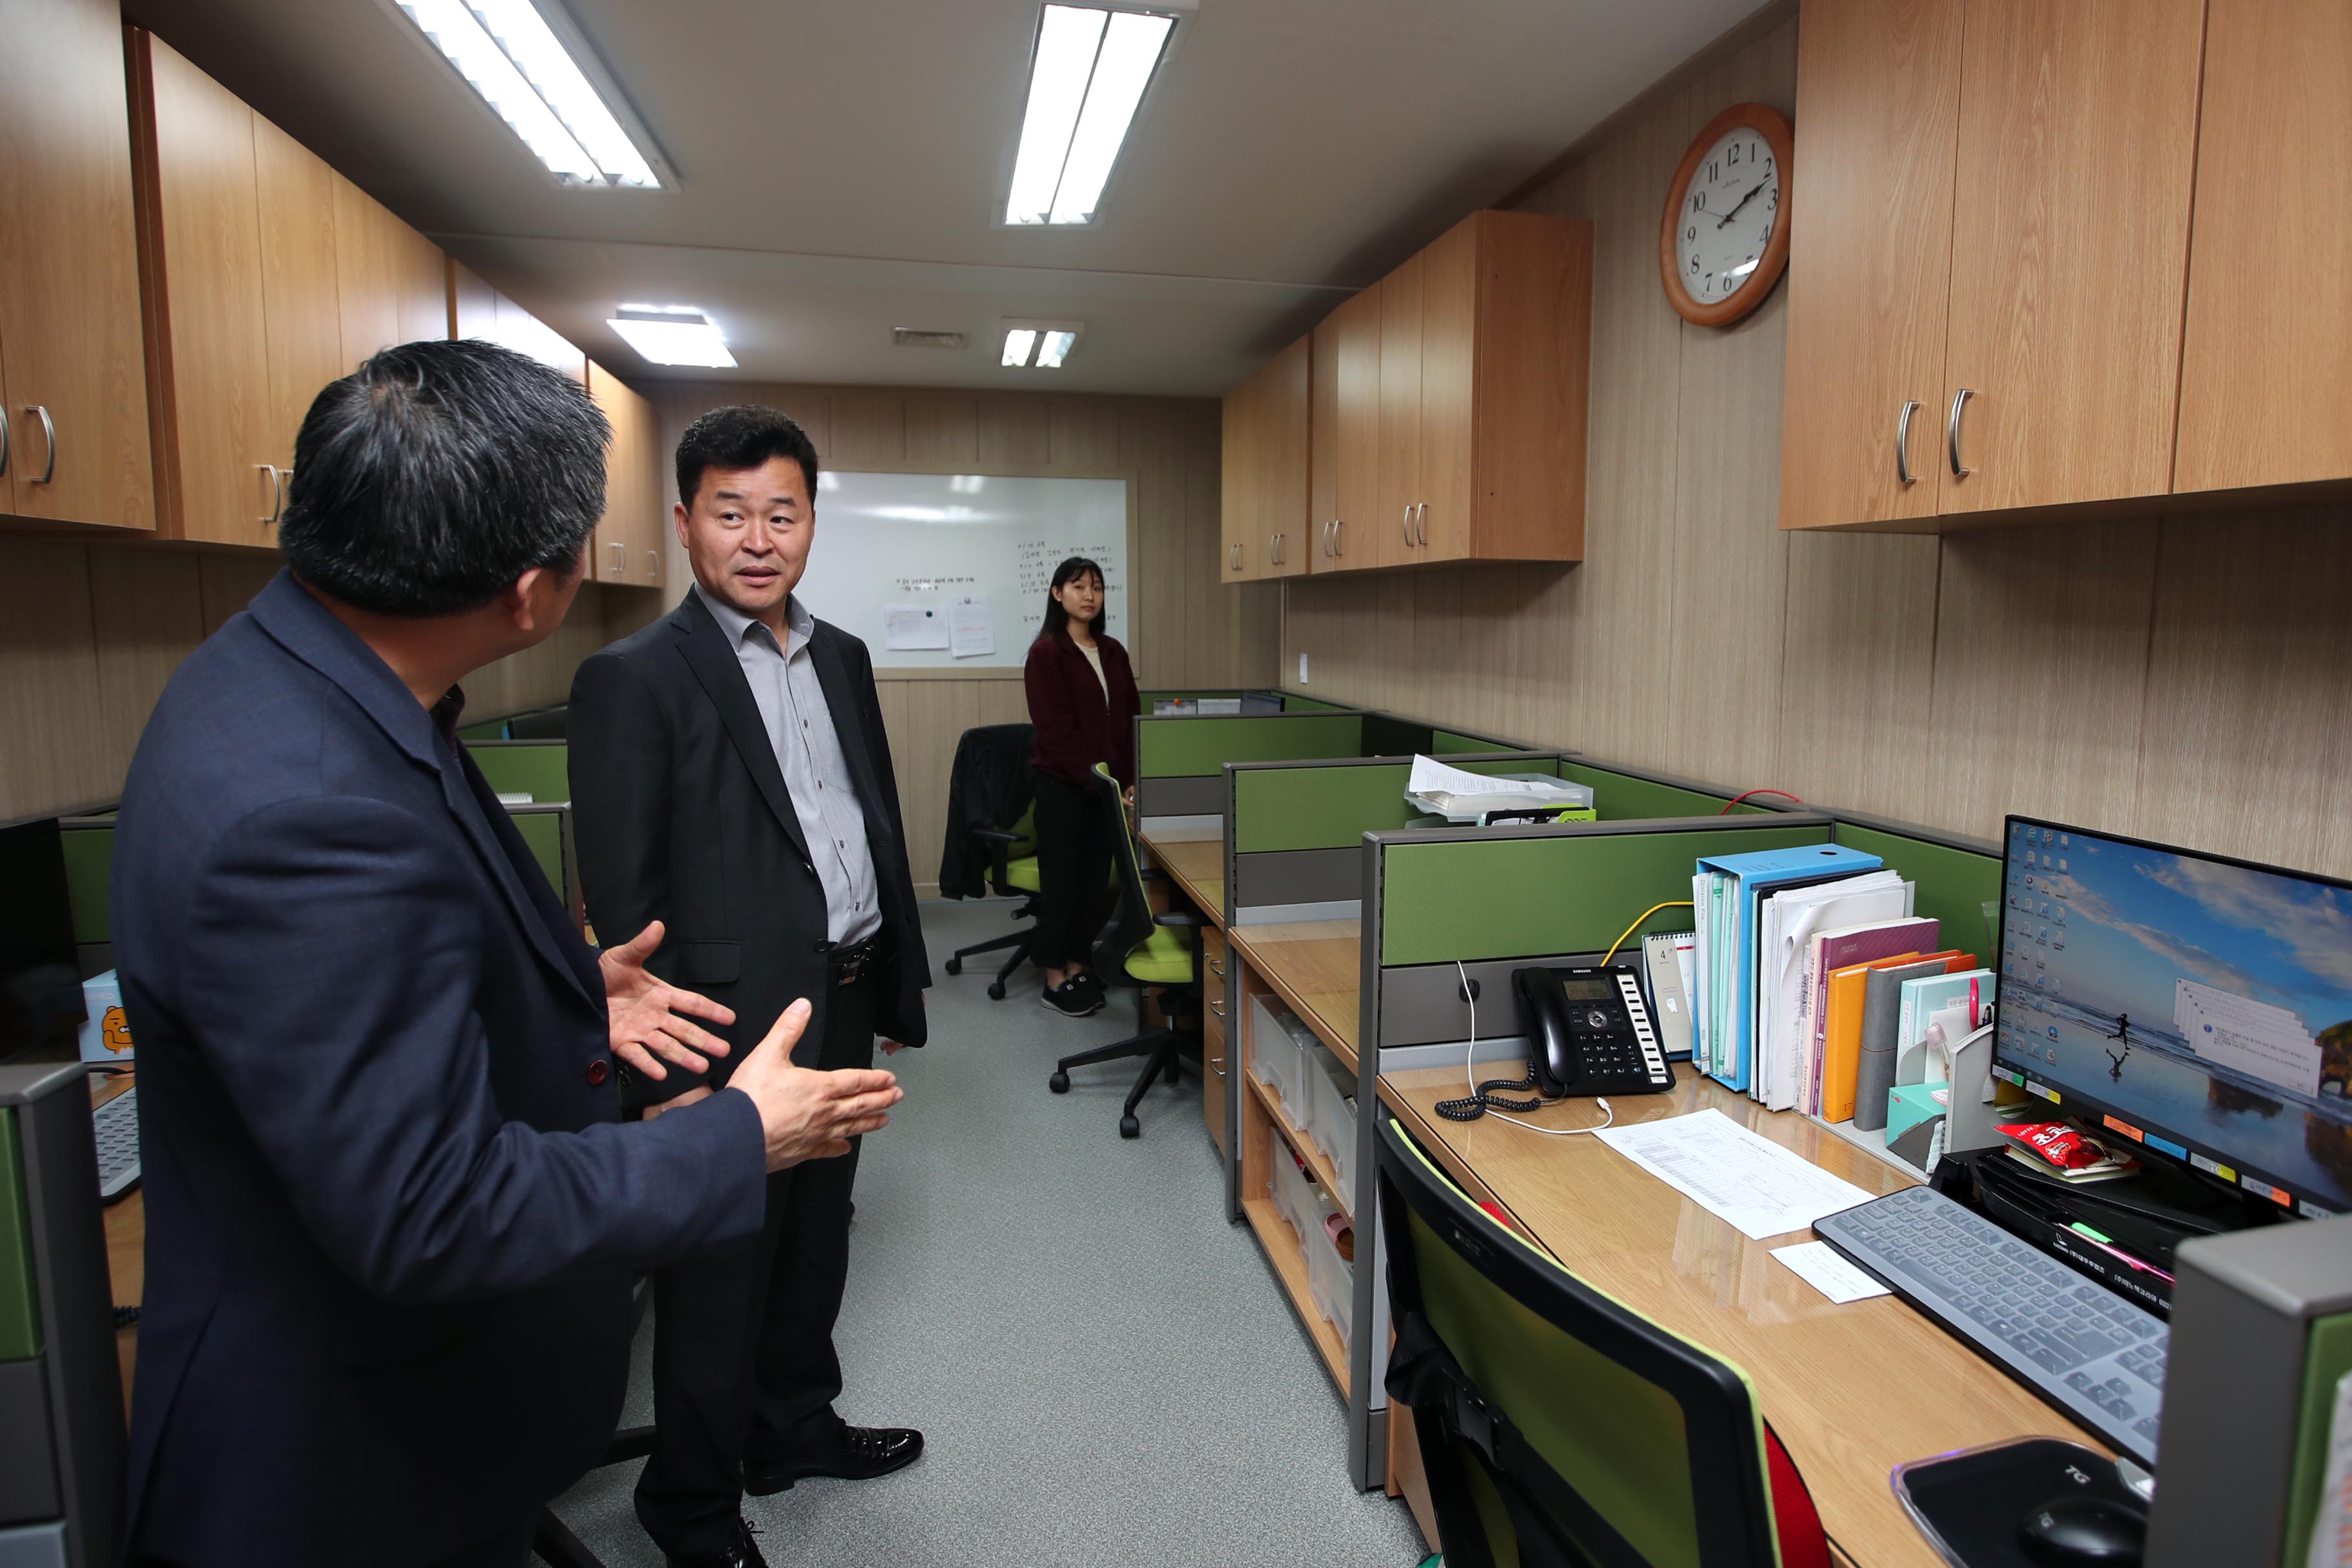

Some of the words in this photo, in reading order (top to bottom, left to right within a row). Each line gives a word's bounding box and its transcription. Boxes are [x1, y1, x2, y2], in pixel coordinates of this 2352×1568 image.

[1727, 142, 1740, 166] 12
[1751, 142, 1756, 163] 1
[1709, 162, 1718, 183] 11
[1763, 157, 1772, 179] 2
[1693, 191, 1706, 213] 10
[1767, 188, 1778, 210] 3
[1687, 226, 1696, 246] 9
[1759, 224, 1769, 244] 4
[1691, 254, 1700, 274] 8
[1705, 272, 1713, 292] 7
[1660, 950, 1666, 959] 4
[1843, 1102, 1853, 1112] 17
[2017, 1126, 2034, 1137] LOTTE
[2065, 1465, 2091, 1484] TG
